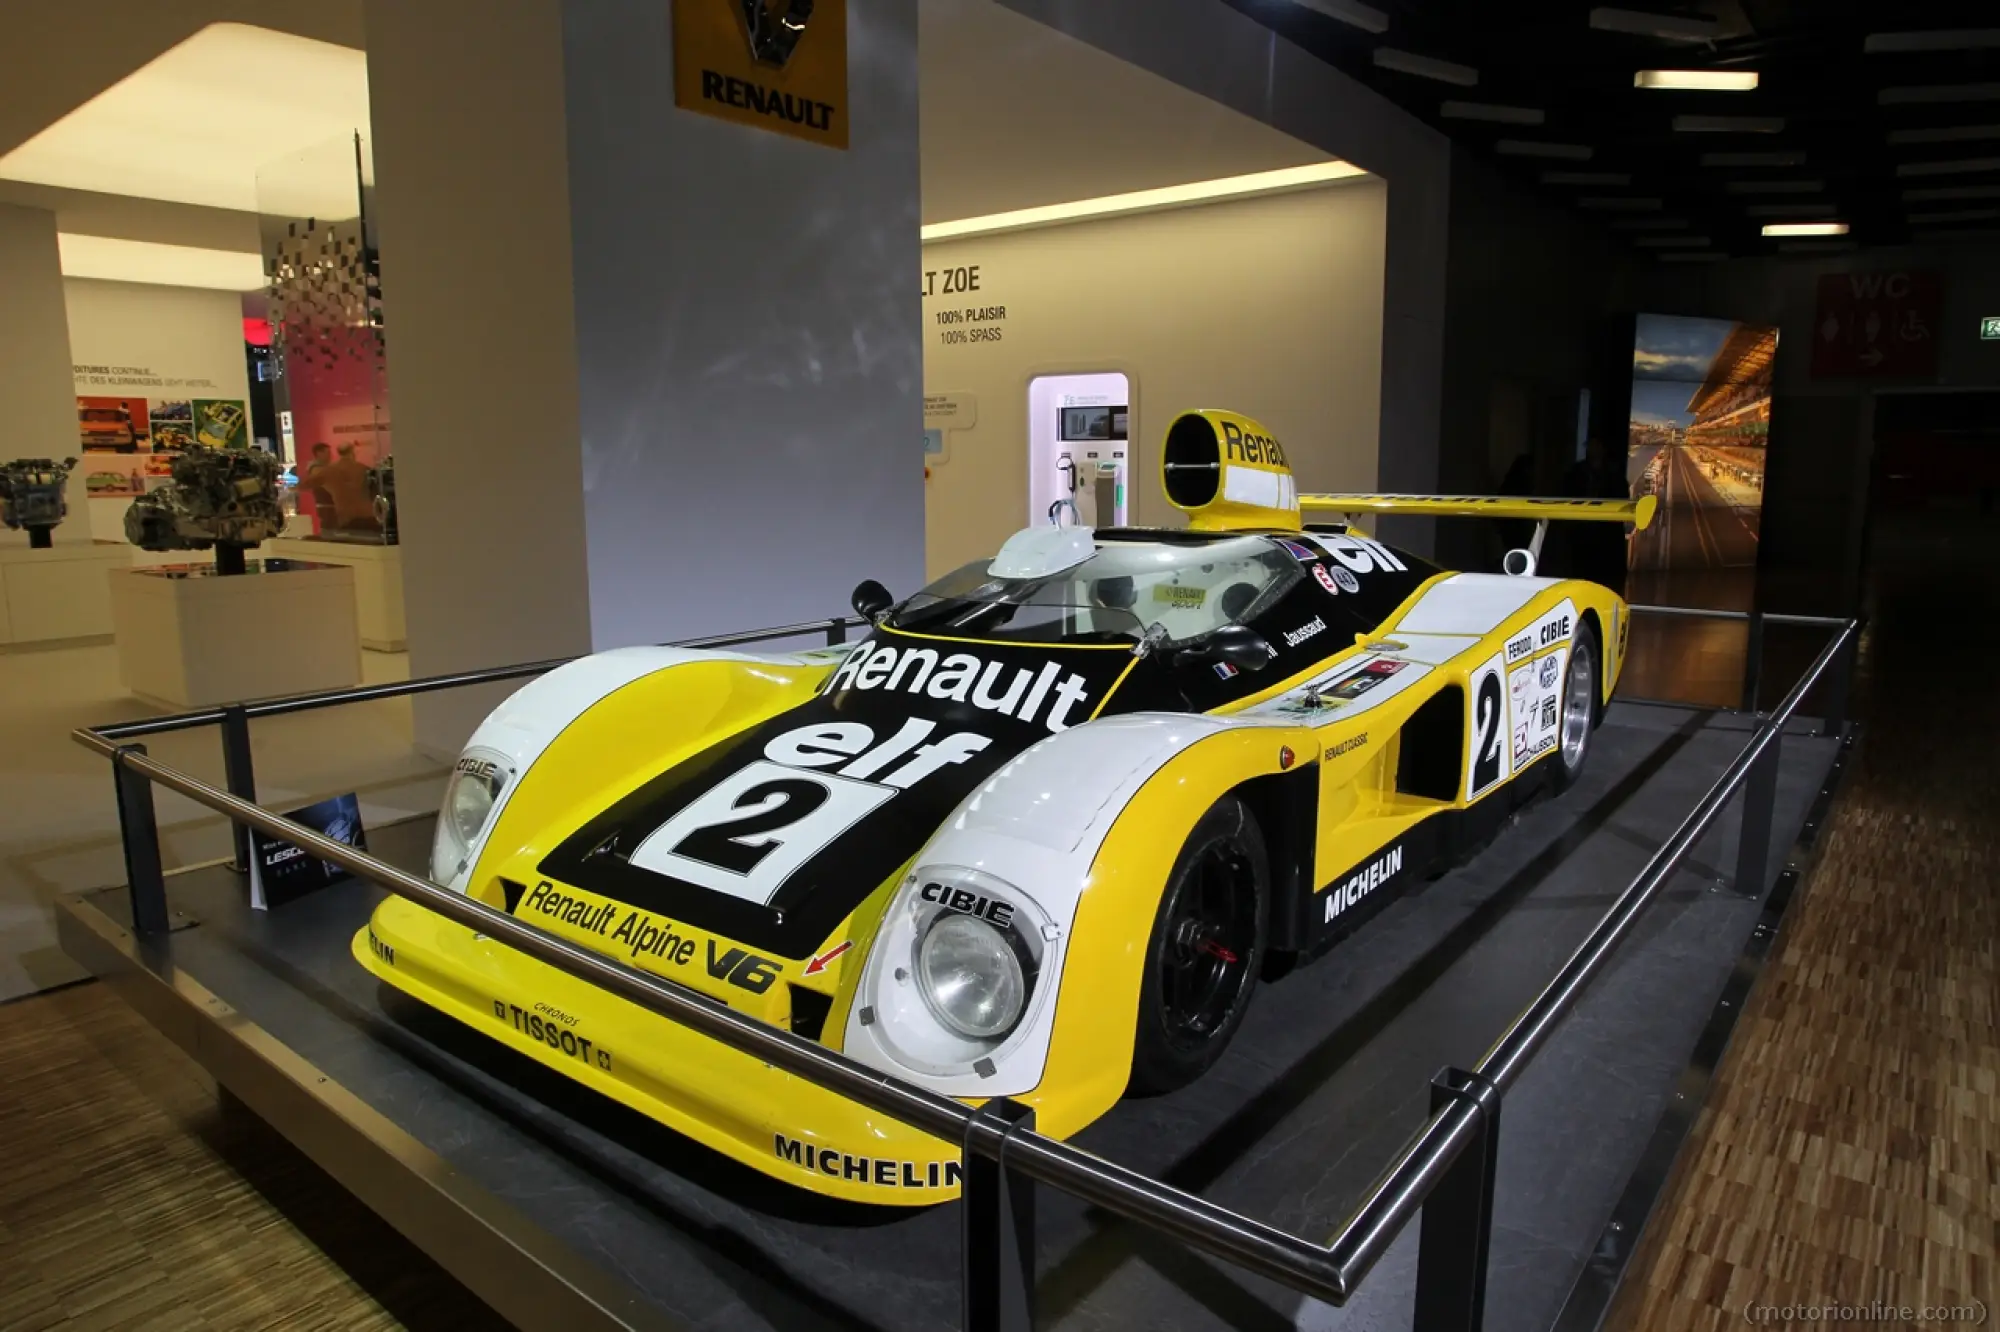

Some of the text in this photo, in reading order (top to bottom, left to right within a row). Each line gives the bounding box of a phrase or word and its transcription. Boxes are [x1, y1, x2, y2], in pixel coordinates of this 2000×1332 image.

[702, 68, 835, 131] RENAULT
[942, 265, 981, 295] ZOE
[1849, 271, 1911, 300] WC
[936, 305, 1007, 325] 100% PLAISIR
[940, 327, 1002, 345] 100% SPASS
[1283, 614, 1328, 648] Jaussaud
[824, 640, 1088, 735] Renault
[763, 716, 993, 789] elf
[1472, 669, 1502, 794] 2
[667, 778, 832, 878] 2
[920, 882, 1015, 928] CIBIE
[1324, 845, 1403, 924] MICHELIN
[525, 880, 784, 995] Renault Alpine V6
[510, 1004, 592, 1064] TISSOT
[533, 1001, 580, 1027] CHRONOS
[774, 1131, 962, 1189] MICHELIN
